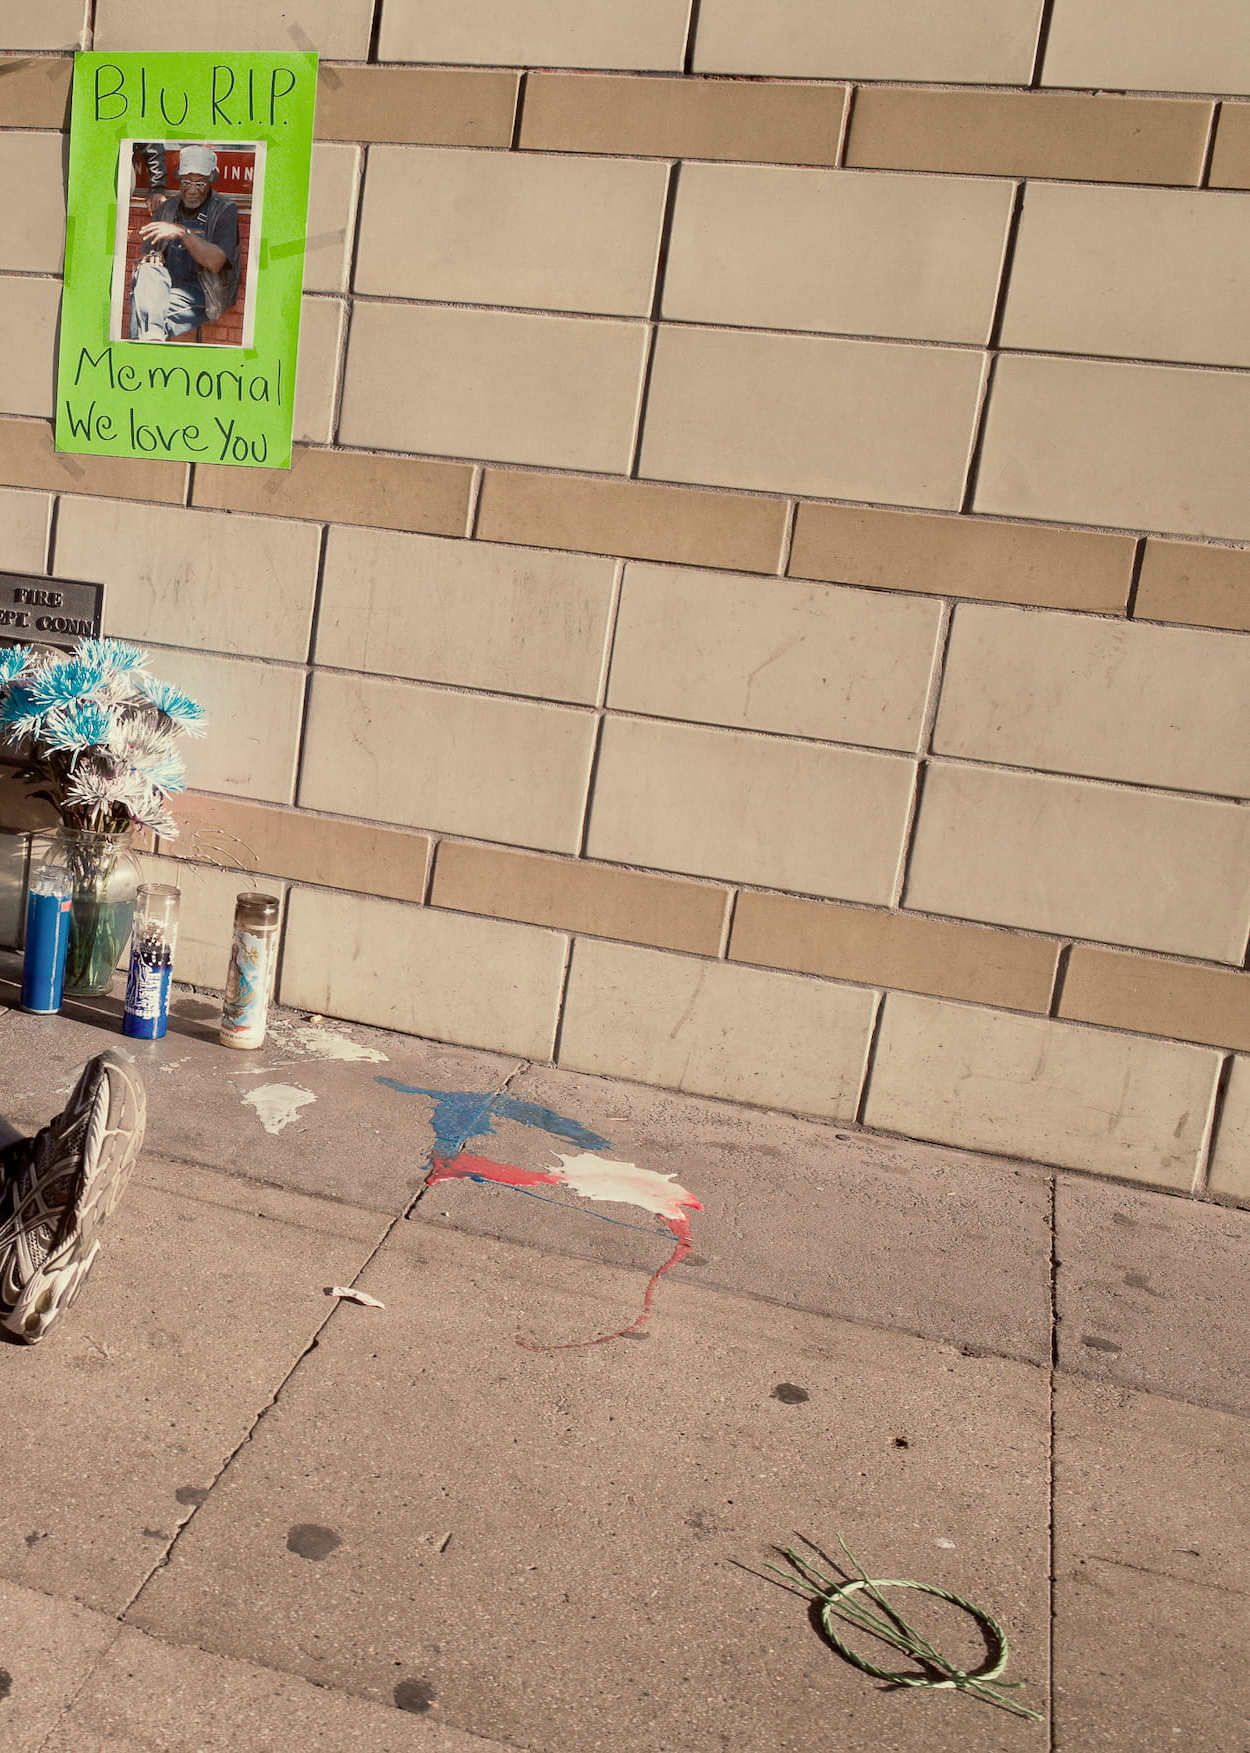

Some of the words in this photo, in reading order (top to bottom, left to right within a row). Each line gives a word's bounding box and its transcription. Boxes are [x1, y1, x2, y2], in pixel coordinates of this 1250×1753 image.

[212, 65, 296, 126] R.I.P.
[74, 347, 281, 406] Memorial
[66, 400, 118, 441] We
[130, 408, 209, 452] love
[214, 417, 268, 463] You
[14, 587, 64, 608] FIRE
